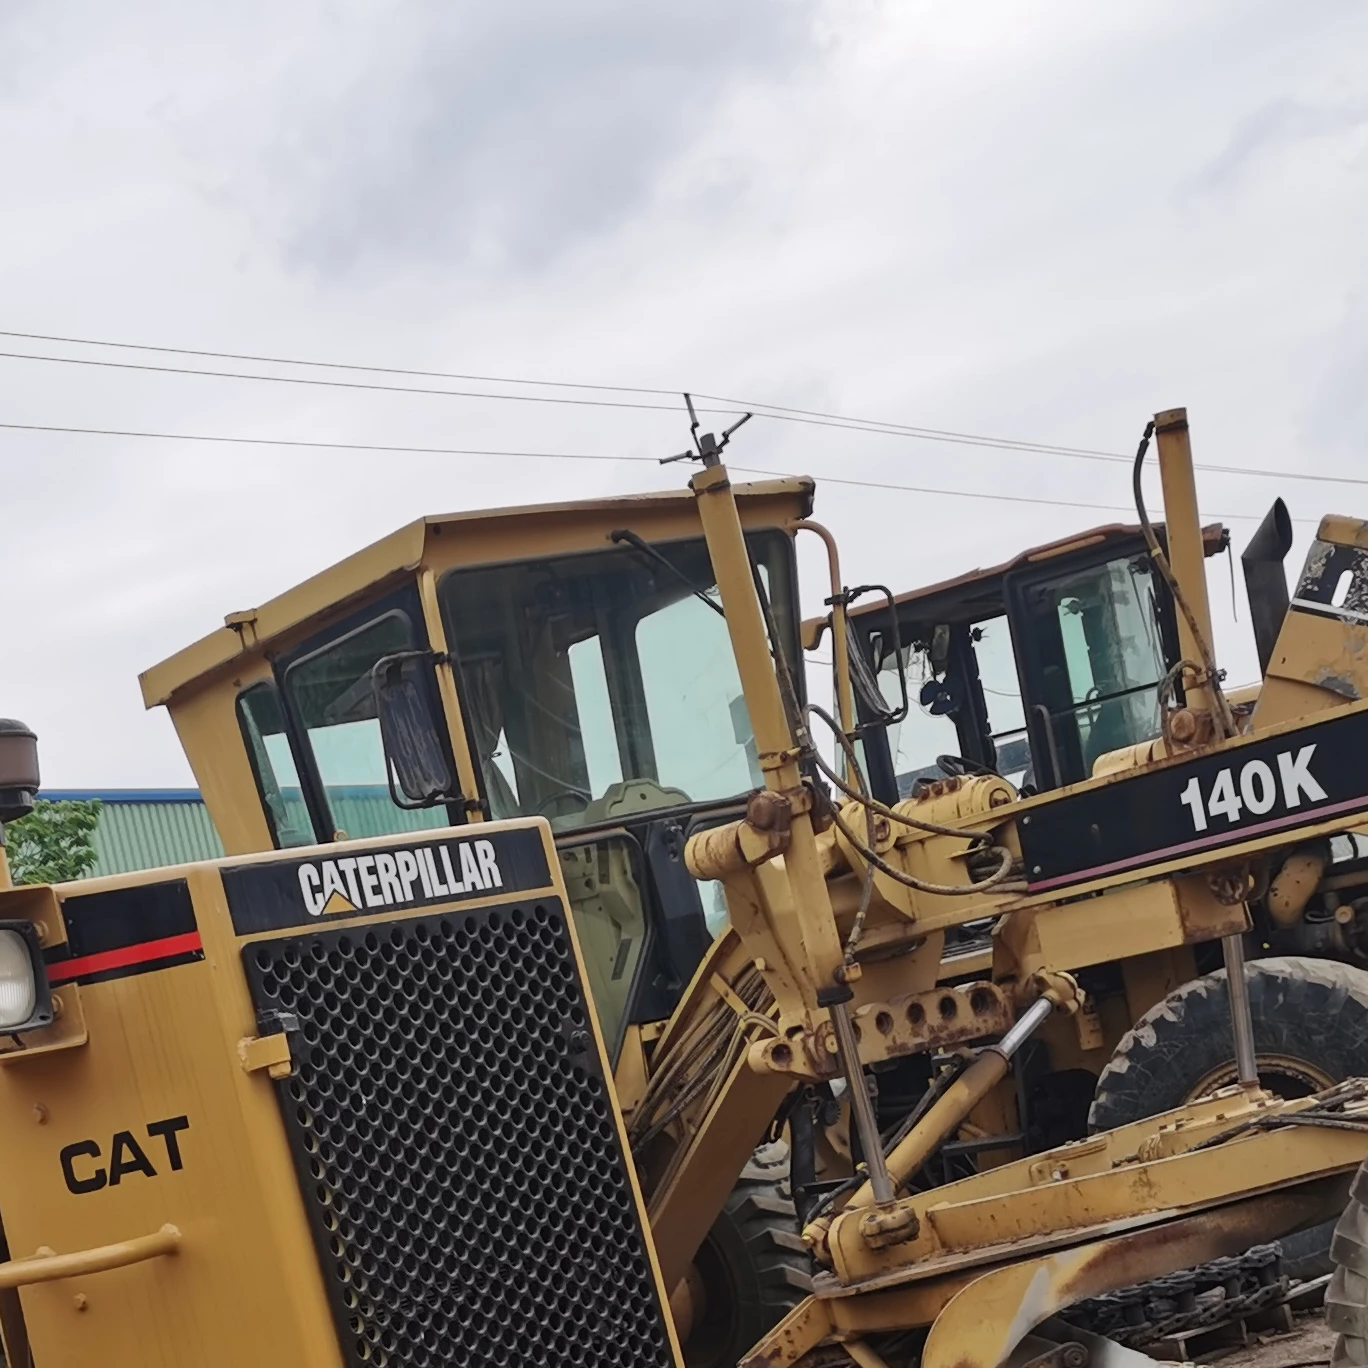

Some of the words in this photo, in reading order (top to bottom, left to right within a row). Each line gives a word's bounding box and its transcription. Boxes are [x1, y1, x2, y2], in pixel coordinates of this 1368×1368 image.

[1180, 743, 1329, 831] 140K
[298, 839, 504, 917] CATERPILLAR
[59, 1114, 190, 1195] CAT
